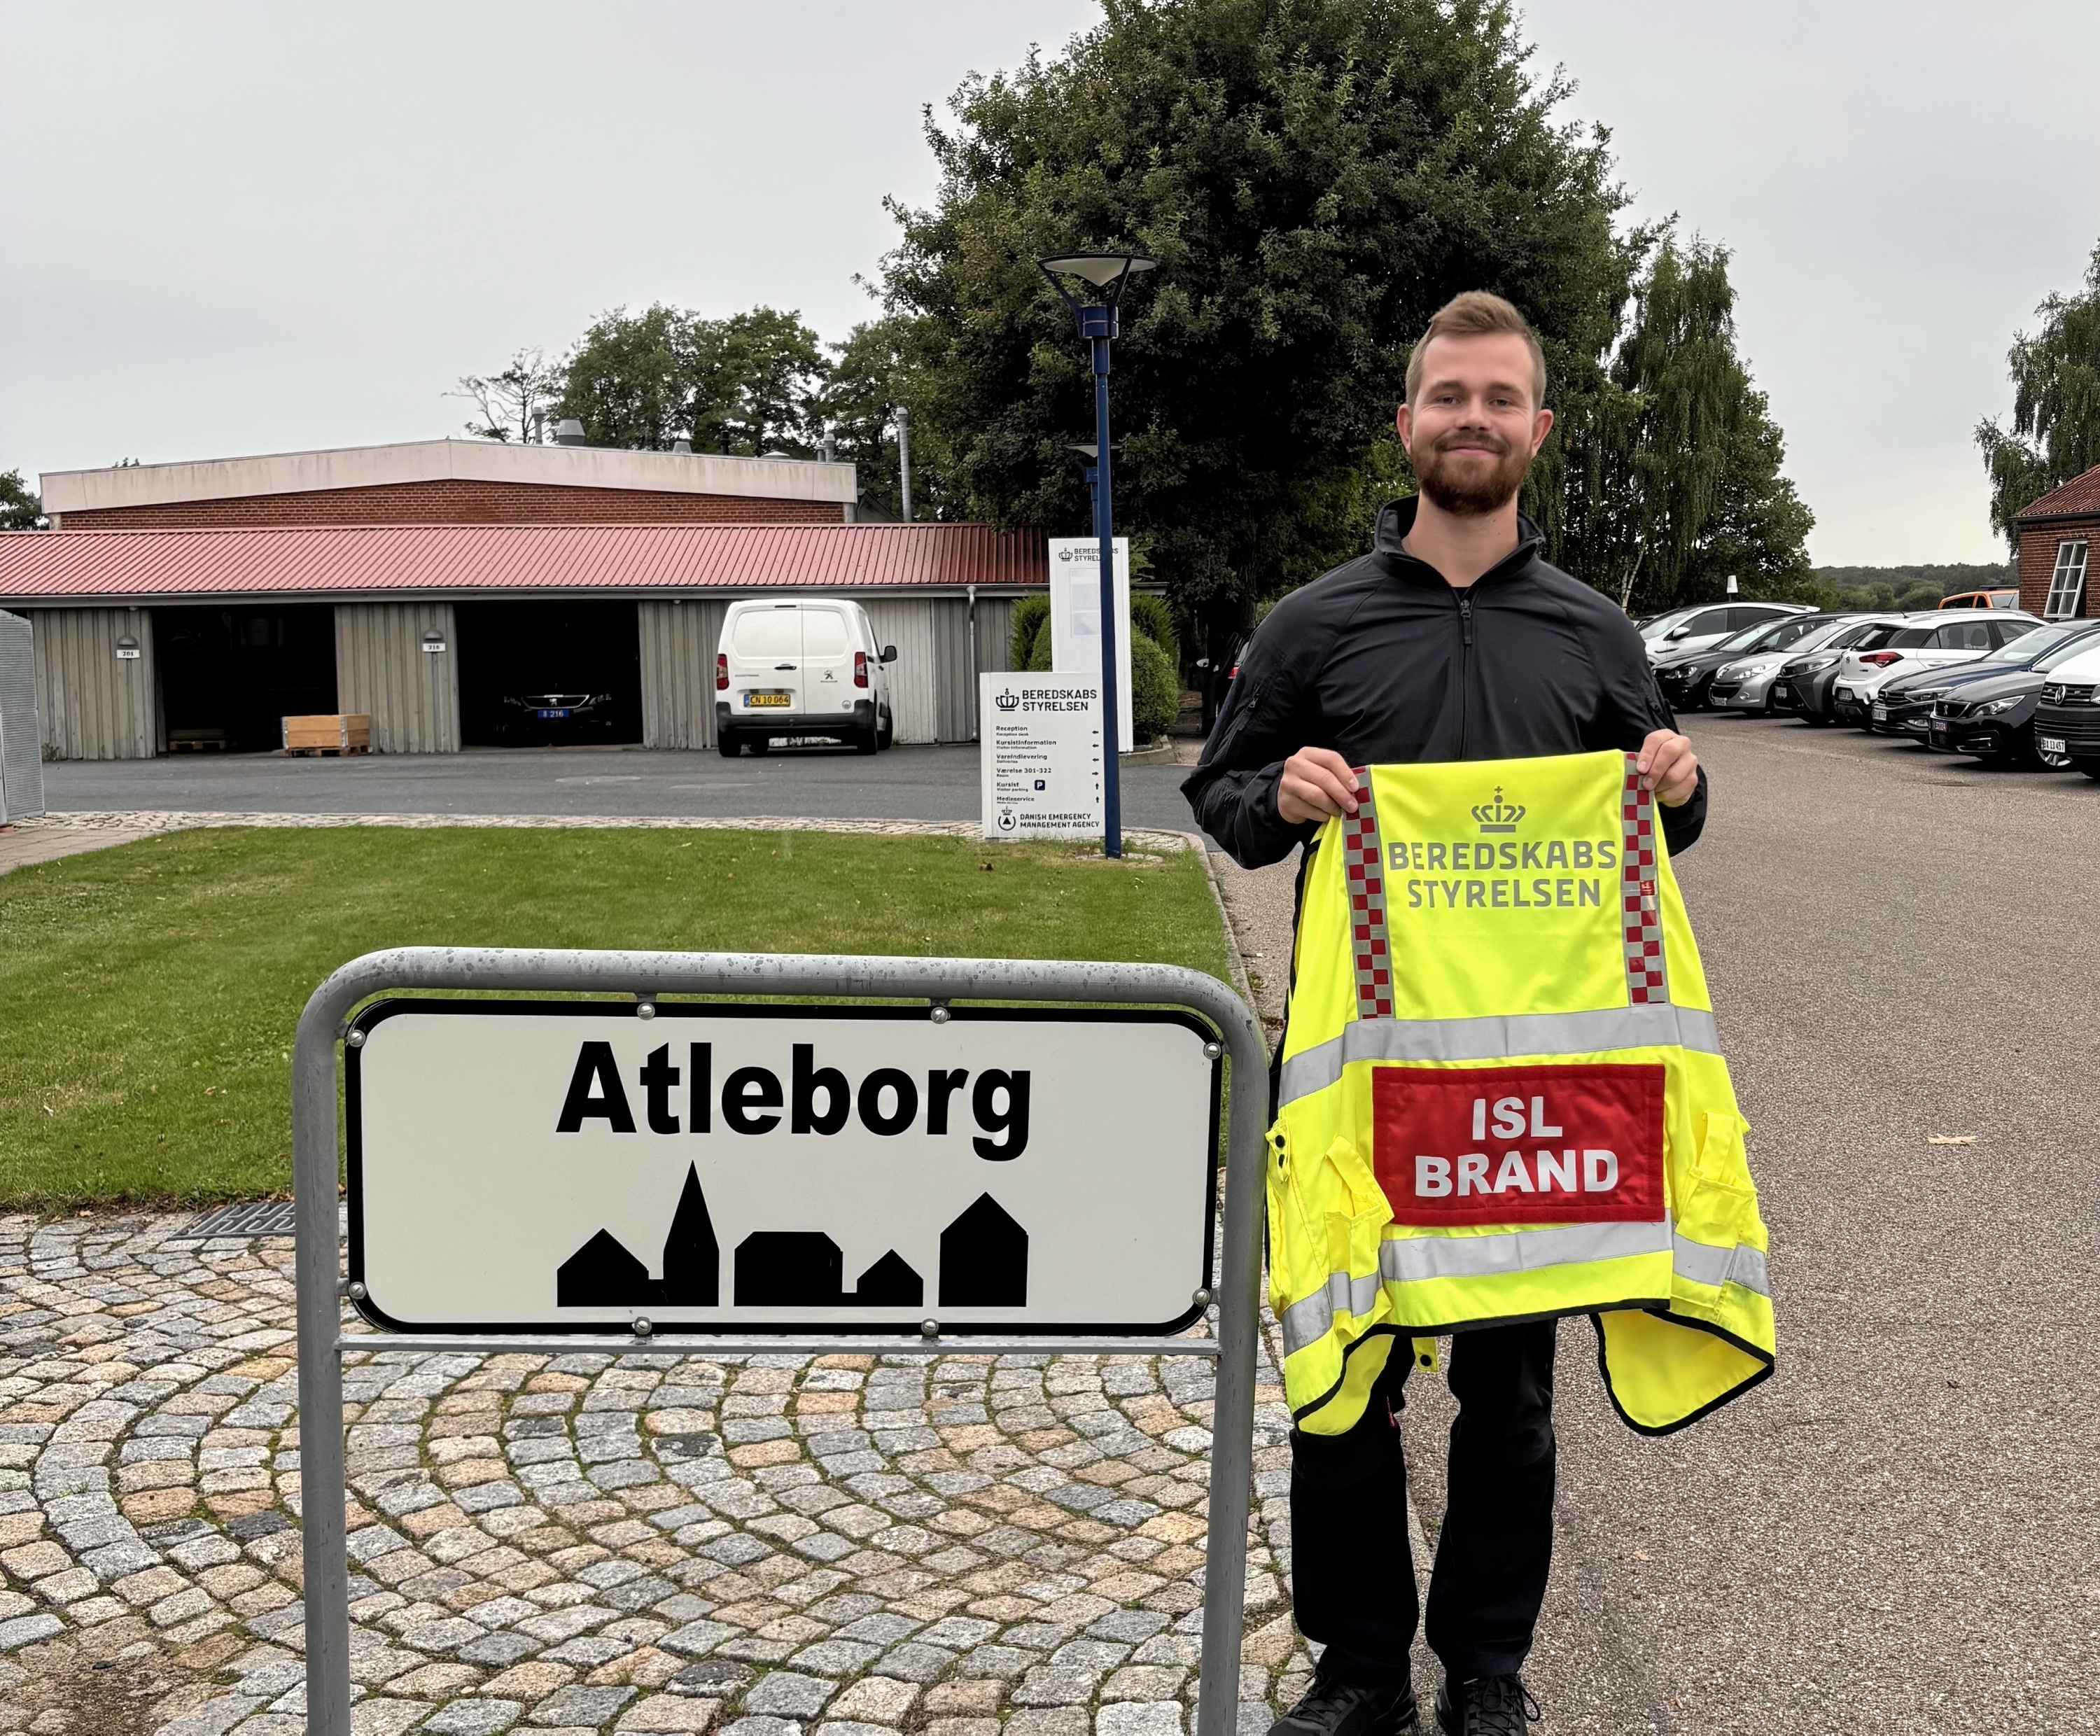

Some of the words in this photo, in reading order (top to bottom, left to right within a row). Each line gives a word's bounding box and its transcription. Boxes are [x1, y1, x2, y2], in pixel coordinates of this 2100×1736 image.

[750, 696, 761, 704] CN
[774, 695, 790, 704] 064
[1022, 690, 1097, 699] BEREDSKABS
[1022, 701, 1088, 711] STYRELSEN
[1388, 839, 1616, 871] BEREDSKABS
[1407, 878, 1600, 909] STYRELSEN
[556, 1041, 1031, 1163] Atleborg
[1472, 1096, 1563, 1141] ISL
[1415, 1149, 1618, 1198] BRAND
